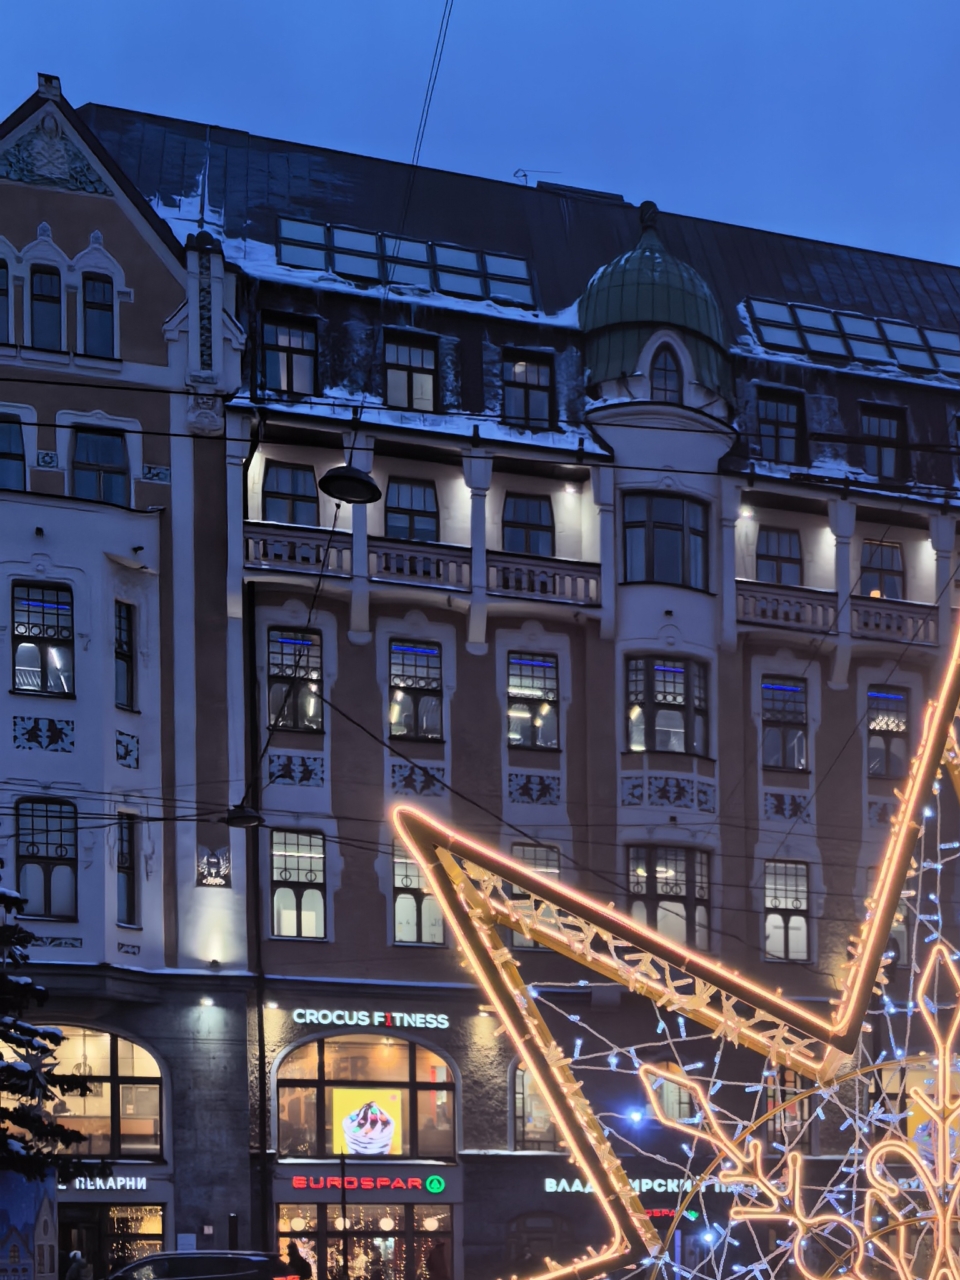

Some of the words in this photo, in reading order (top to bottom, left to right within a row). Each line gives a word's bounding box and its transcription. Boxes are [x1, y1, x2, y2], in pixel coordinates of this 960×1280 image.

[292, 1008, 370, 1026] CROCUS
[75, 1176, 147, 1190] ПЕКАРНИ
[292, 1175, 423, 1190] EUROSPAR
[544, 1175, 706, 1193] ВЛАДИРСКИЙ
